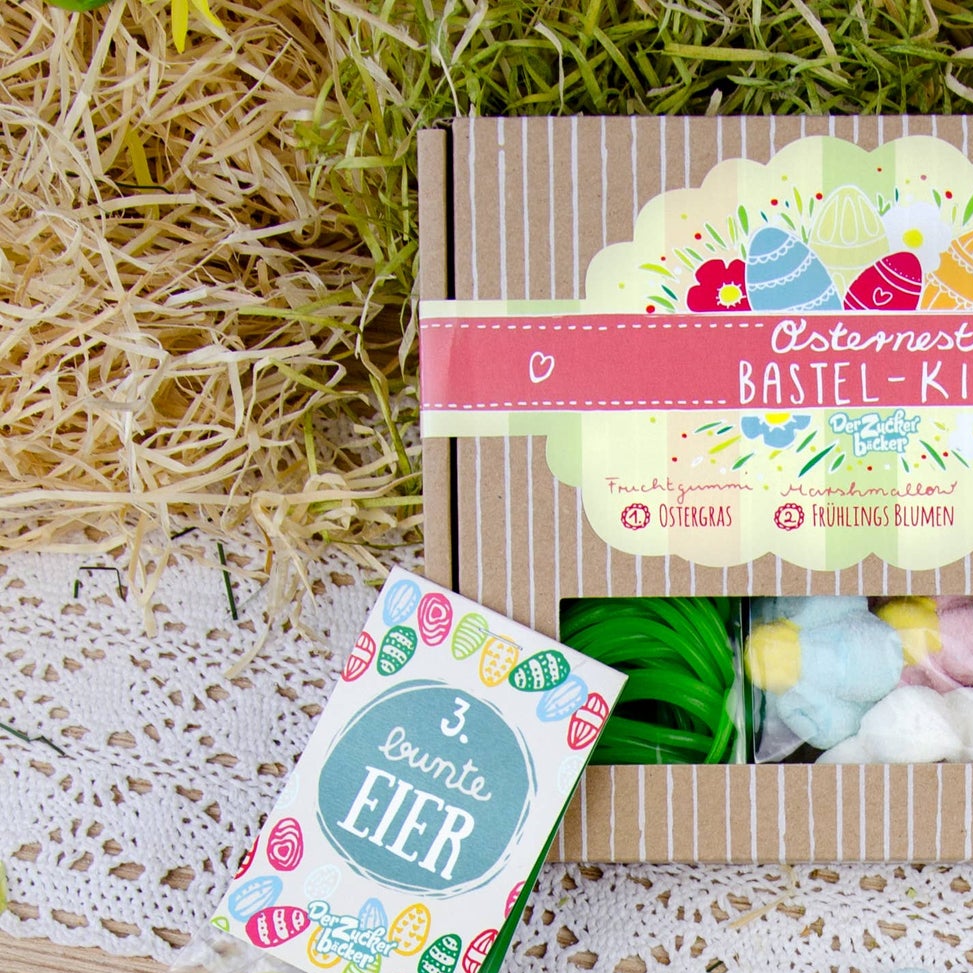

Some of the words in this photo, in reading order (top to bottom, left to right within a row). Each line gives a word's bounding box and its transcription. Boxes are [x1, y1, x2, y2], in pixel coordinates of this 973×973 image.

[829, 412, 861, 434] Der
[605, 472, 753, 504] Fruchtgummi
[659, 503, 733, 528] OSTERGRAS
[811, 502, 889, 528] FRÜHLINGS
[894, 503, 955, 528] BLUMEN
[440, 697, 471, 744] 3.
[378, 726, 492, 801] bunte
[337, 765, 475, 881] EIER
[307, 899, 343, 927] Der
